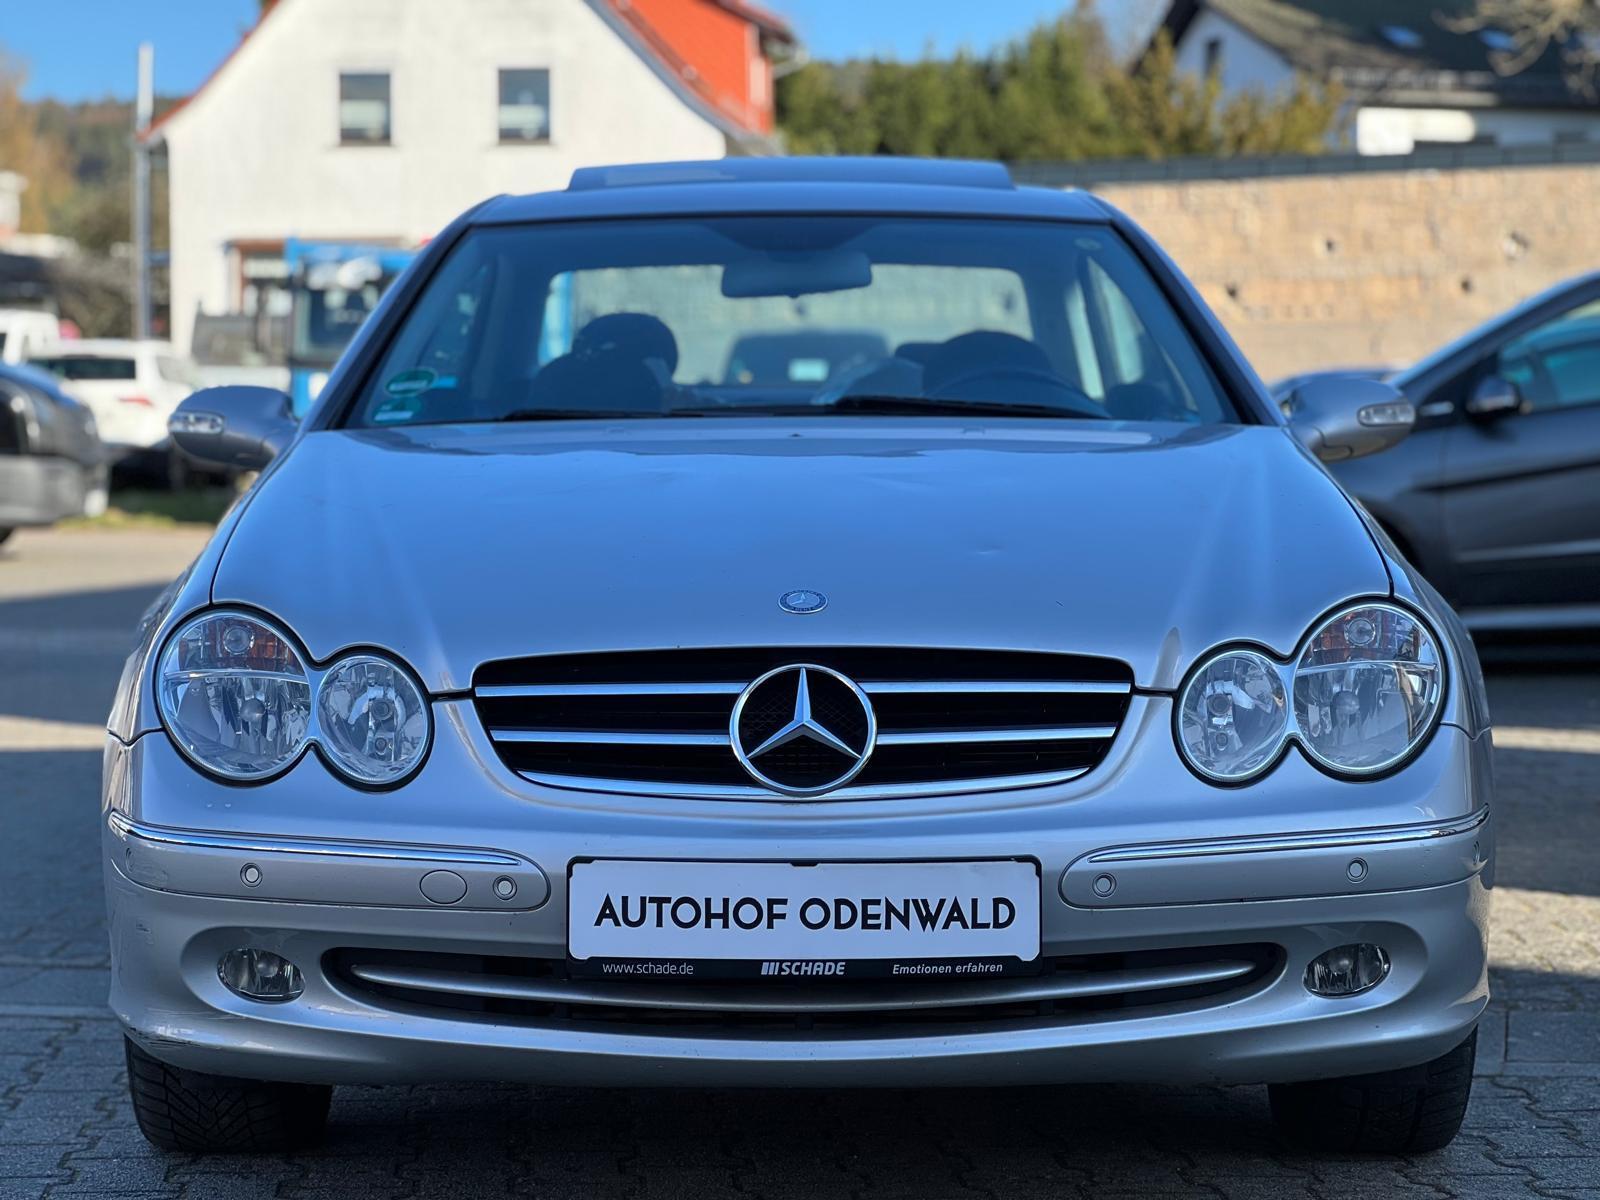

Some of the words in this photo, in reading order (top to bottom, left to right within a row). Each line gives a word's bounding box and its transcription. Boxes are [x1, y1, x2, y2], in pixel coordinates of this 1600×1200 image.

[593, 893, 789, 930] AUTOHOF
[799, 896, 1016, 933] ODENWALD
[602, 962, 694, 976] www.schade.de
[780, 961, 845, 976] SCHADE
[892, 963, 952, 975] Emotionen
[955, 961, 1003, 975] erfahren
